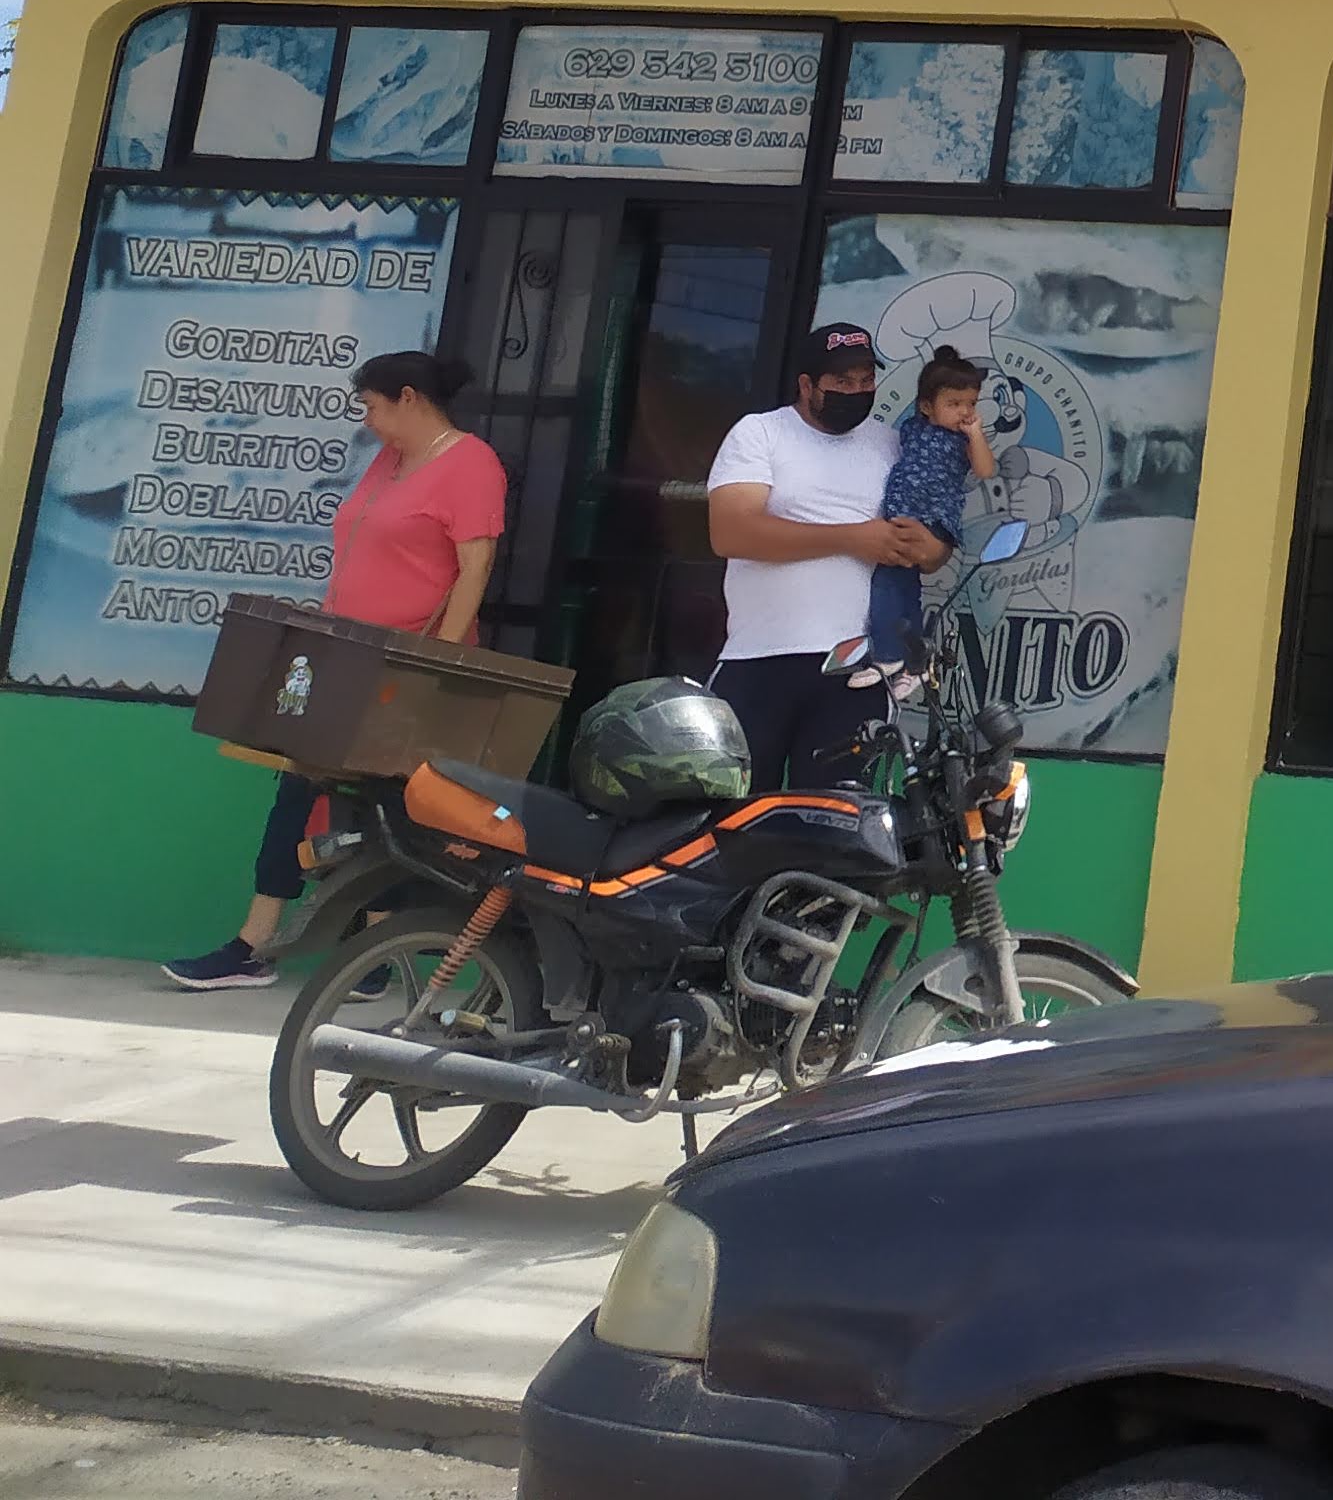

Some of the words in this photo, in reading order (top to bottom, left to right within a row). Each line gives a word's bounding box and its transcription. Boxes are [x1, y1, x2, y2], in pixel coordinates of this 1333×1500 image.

[564, 48, 635, 78] 629
[641, 50, 717, 82] 542
[723, 52, 819, 83] 5100
[529, 89, 596, 110] LUNES
[597, 94, 614, 110] A
[716, 95, 733, 114] 8
[734, 97, 769, 115] AM
[770, 98, 787, 115] A
[789, 97, 808, 116] 9
[597, 126, 614, 142] Y
[735, 128, 752, 147] 8
[753, 131, 788, 148] AM
[849, 137, 883, 155] PM
[127, 236, 359, 289] VARIEDAD
[366, 249, 437, 294] DE
[166, 319, 359, 369] GORDITAS
[138, 370, 368, 422] DESAYUNOS
[873, 389, 901, 422] 990
[1004, 352, 1053, 385] GRUPO
[1054, 387, 1087, 458] CHANITO
[153, 423, 348, 473] BURRITOS
[128, 473, 343, 526] DOBLADAS
[113, 526, 335, 580] MONTADAS
[977, 557, 1071, 601] Gorditas
